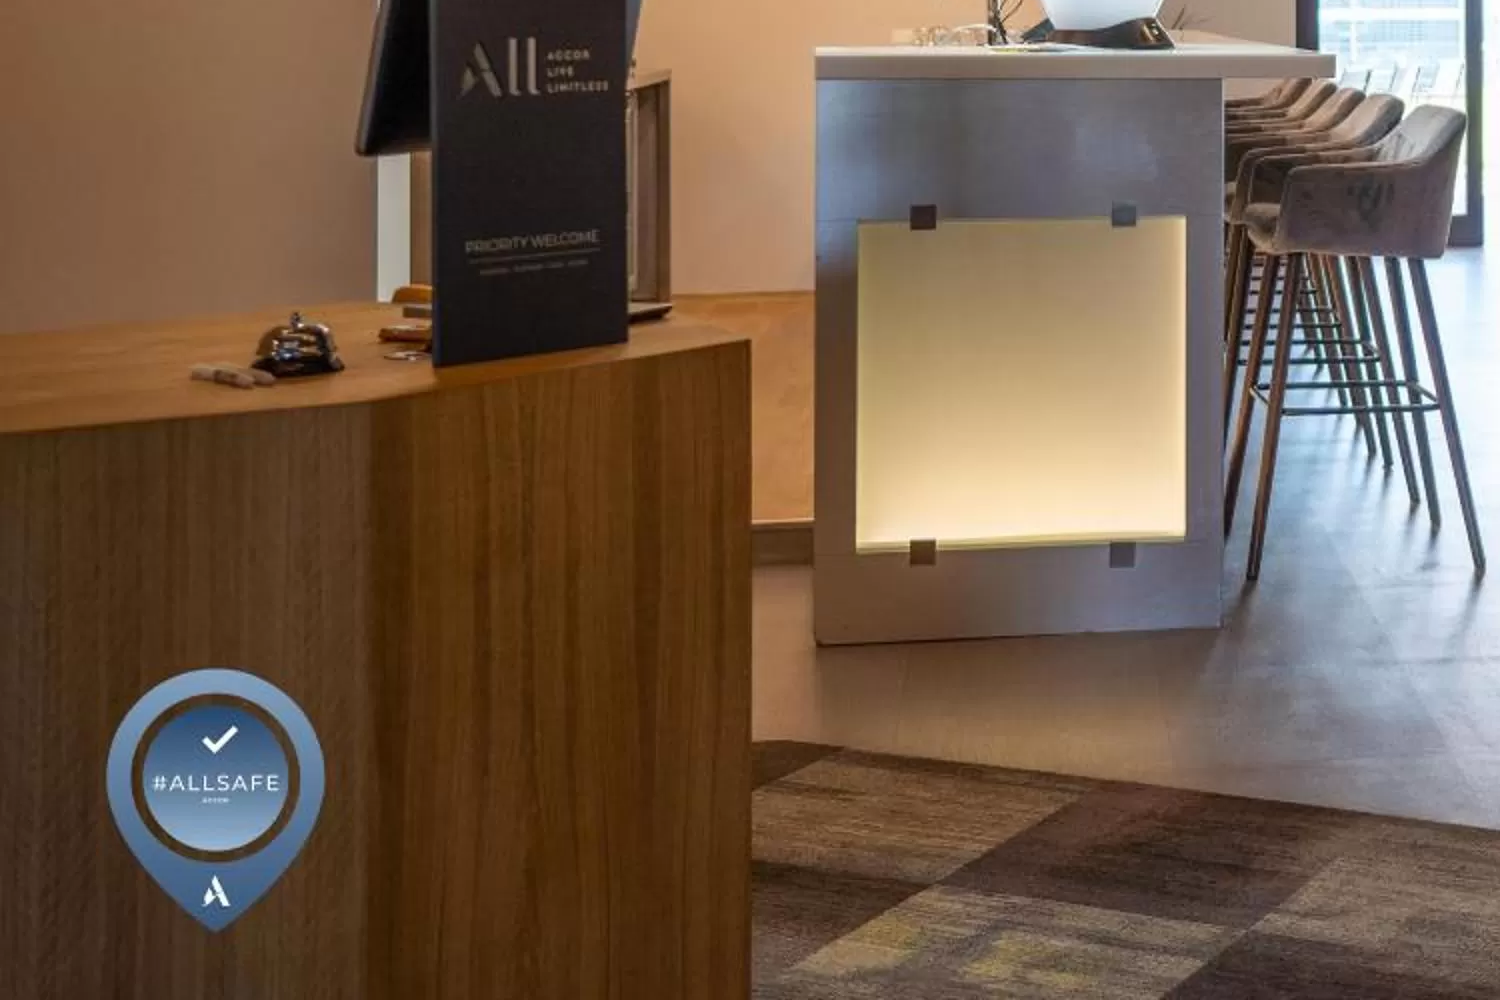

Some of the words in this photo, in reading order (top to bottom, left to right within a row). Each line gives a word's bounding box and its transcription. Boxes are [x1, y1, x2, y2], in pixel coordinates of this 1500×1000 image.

[547, 49, 591, 61] ACCOR
[547, 65, 575, 78] LIVE
[547, 80, 609, 94] LIMITLESS
[464, 235, 529, 254] PRIORITY
[529, 228, 601, 249] WELCOME
